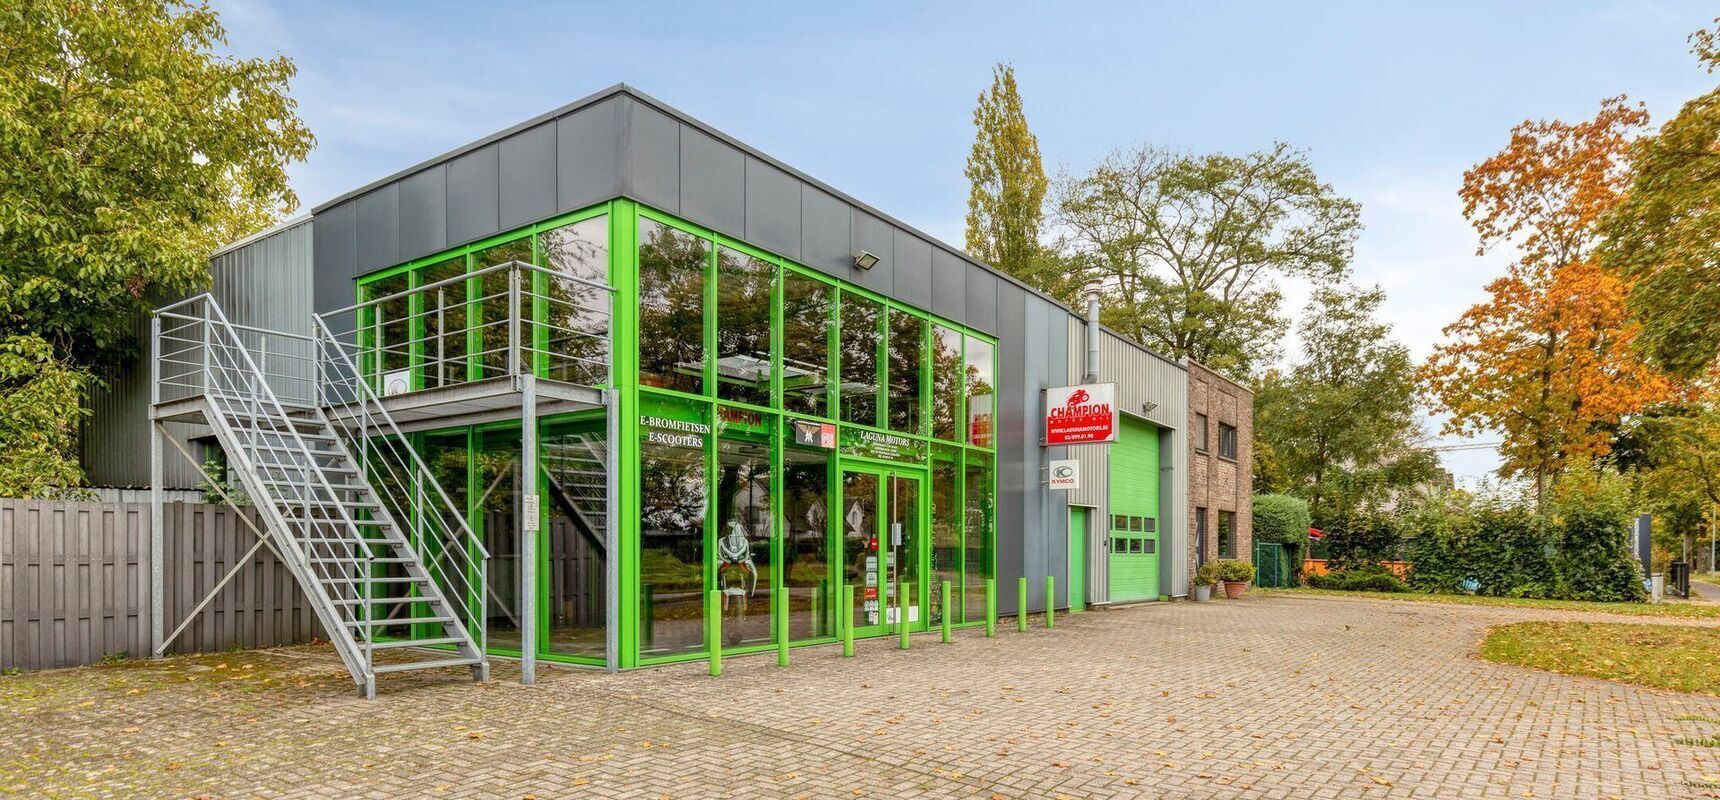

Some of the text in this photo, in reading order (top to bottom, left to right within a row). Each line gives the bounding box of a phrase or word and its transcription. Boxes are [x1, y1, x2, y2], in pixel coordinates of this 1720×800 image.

[1051, 404, 1110, 419] CHAMPION
[640, 415, 711, 434] E-BROMFIETSEN
[649, 432, 703, 448] E-SCOOTERS
[860, 430, 910, 447] LAGUNA MOTORS
